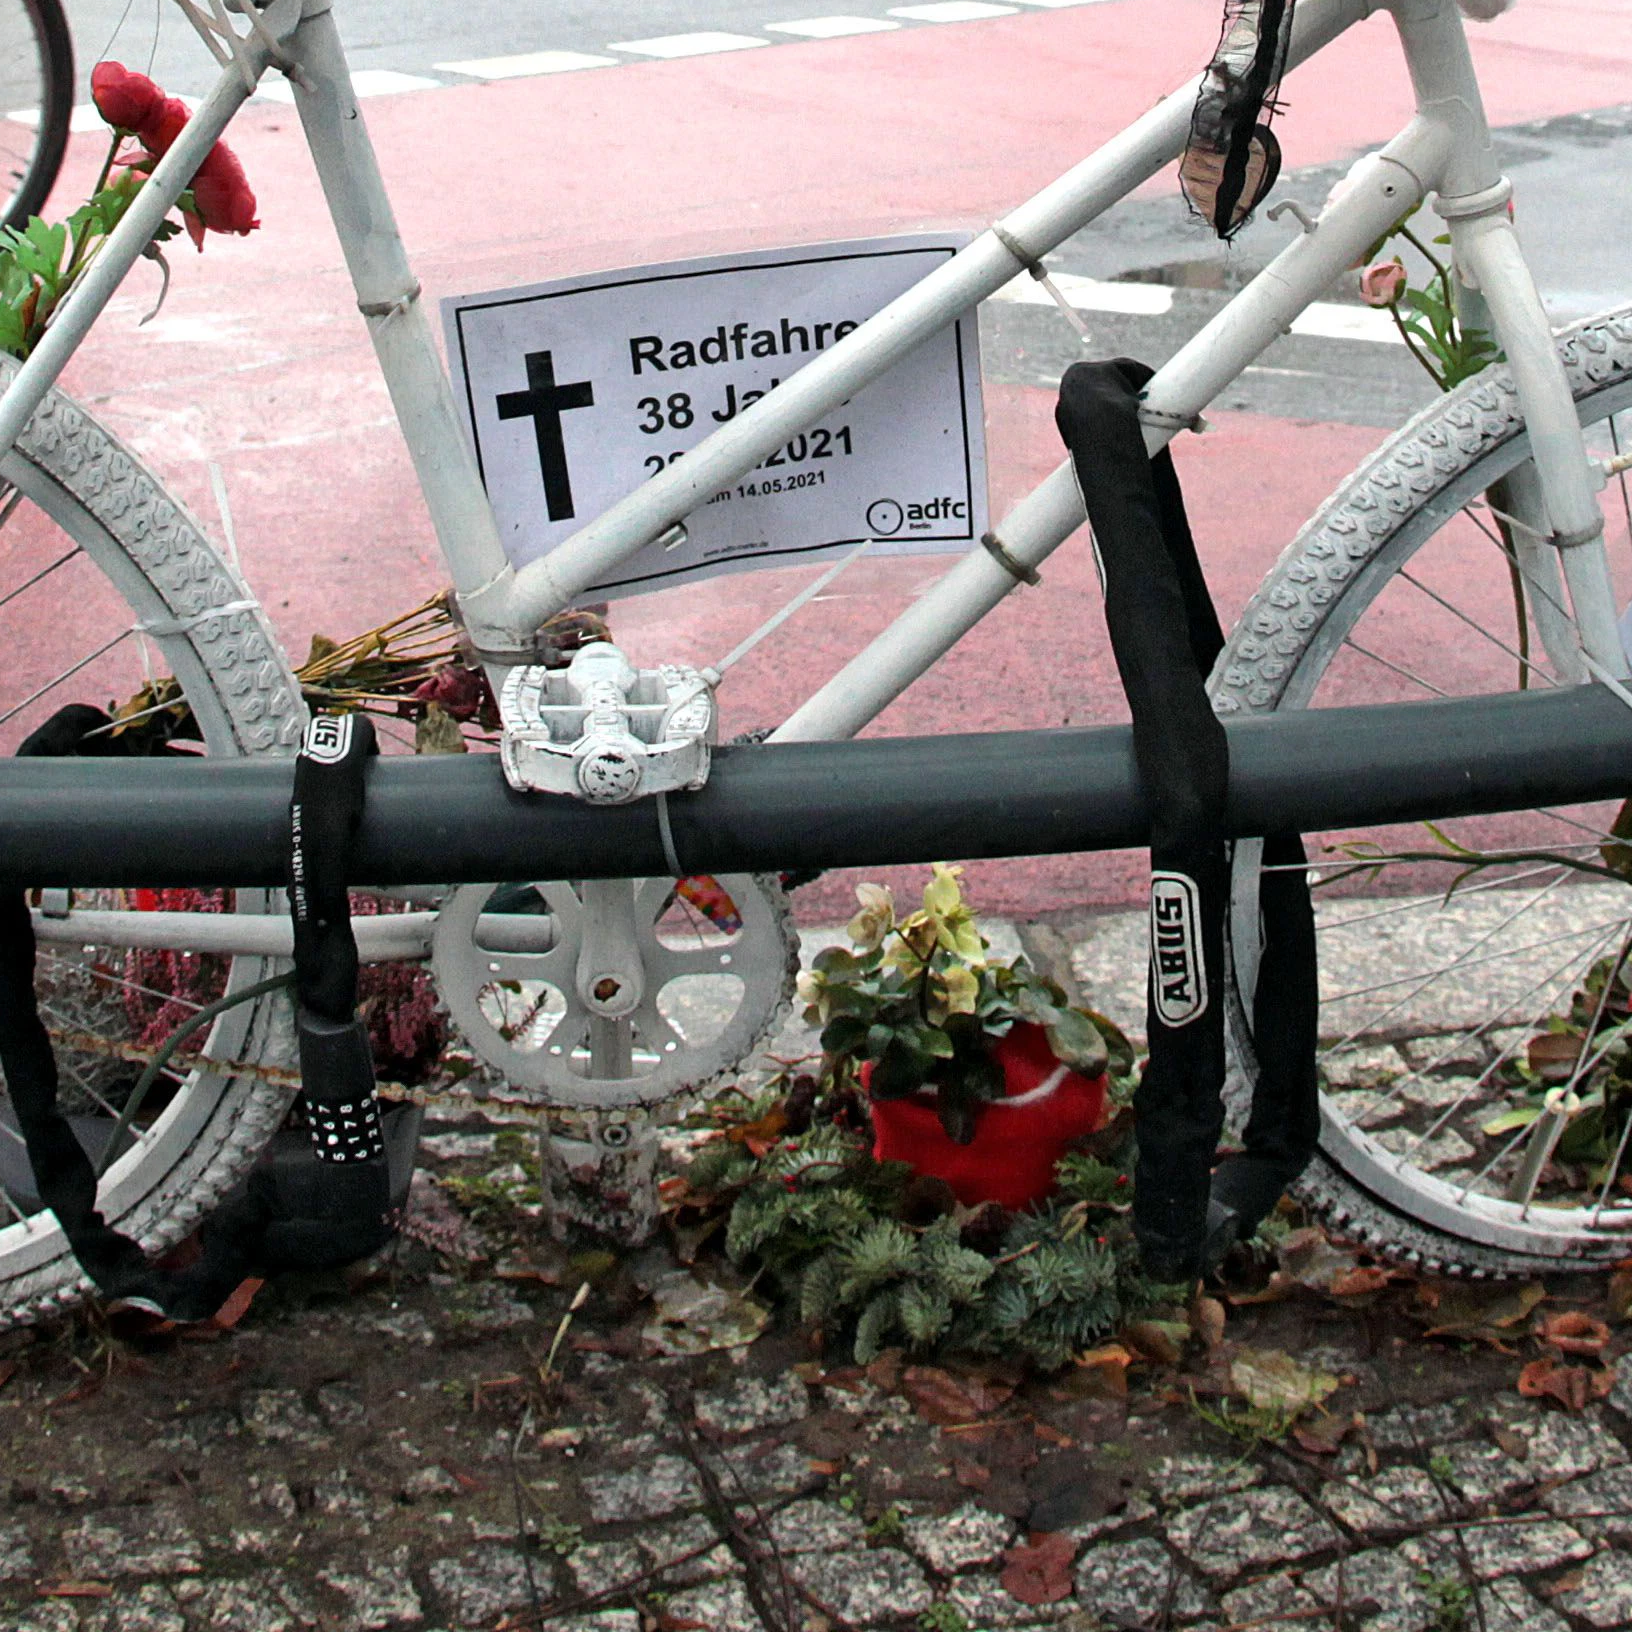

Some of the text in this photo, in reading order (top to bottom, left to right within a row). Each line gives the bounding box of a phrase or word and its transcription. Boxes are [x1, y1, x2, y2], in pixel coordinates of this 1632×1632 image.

[629, 318, 861, 375] Radfahre
[637, 392, 695, 434] 38
[737, 470, 826, 499] 14.05.2021
[907, 496, 967, 520] adfc
[314, 719, 339, 748] US
[292, 804, 301, 833] ABUS
[1155, 895, 1191, 1003] ABUS
